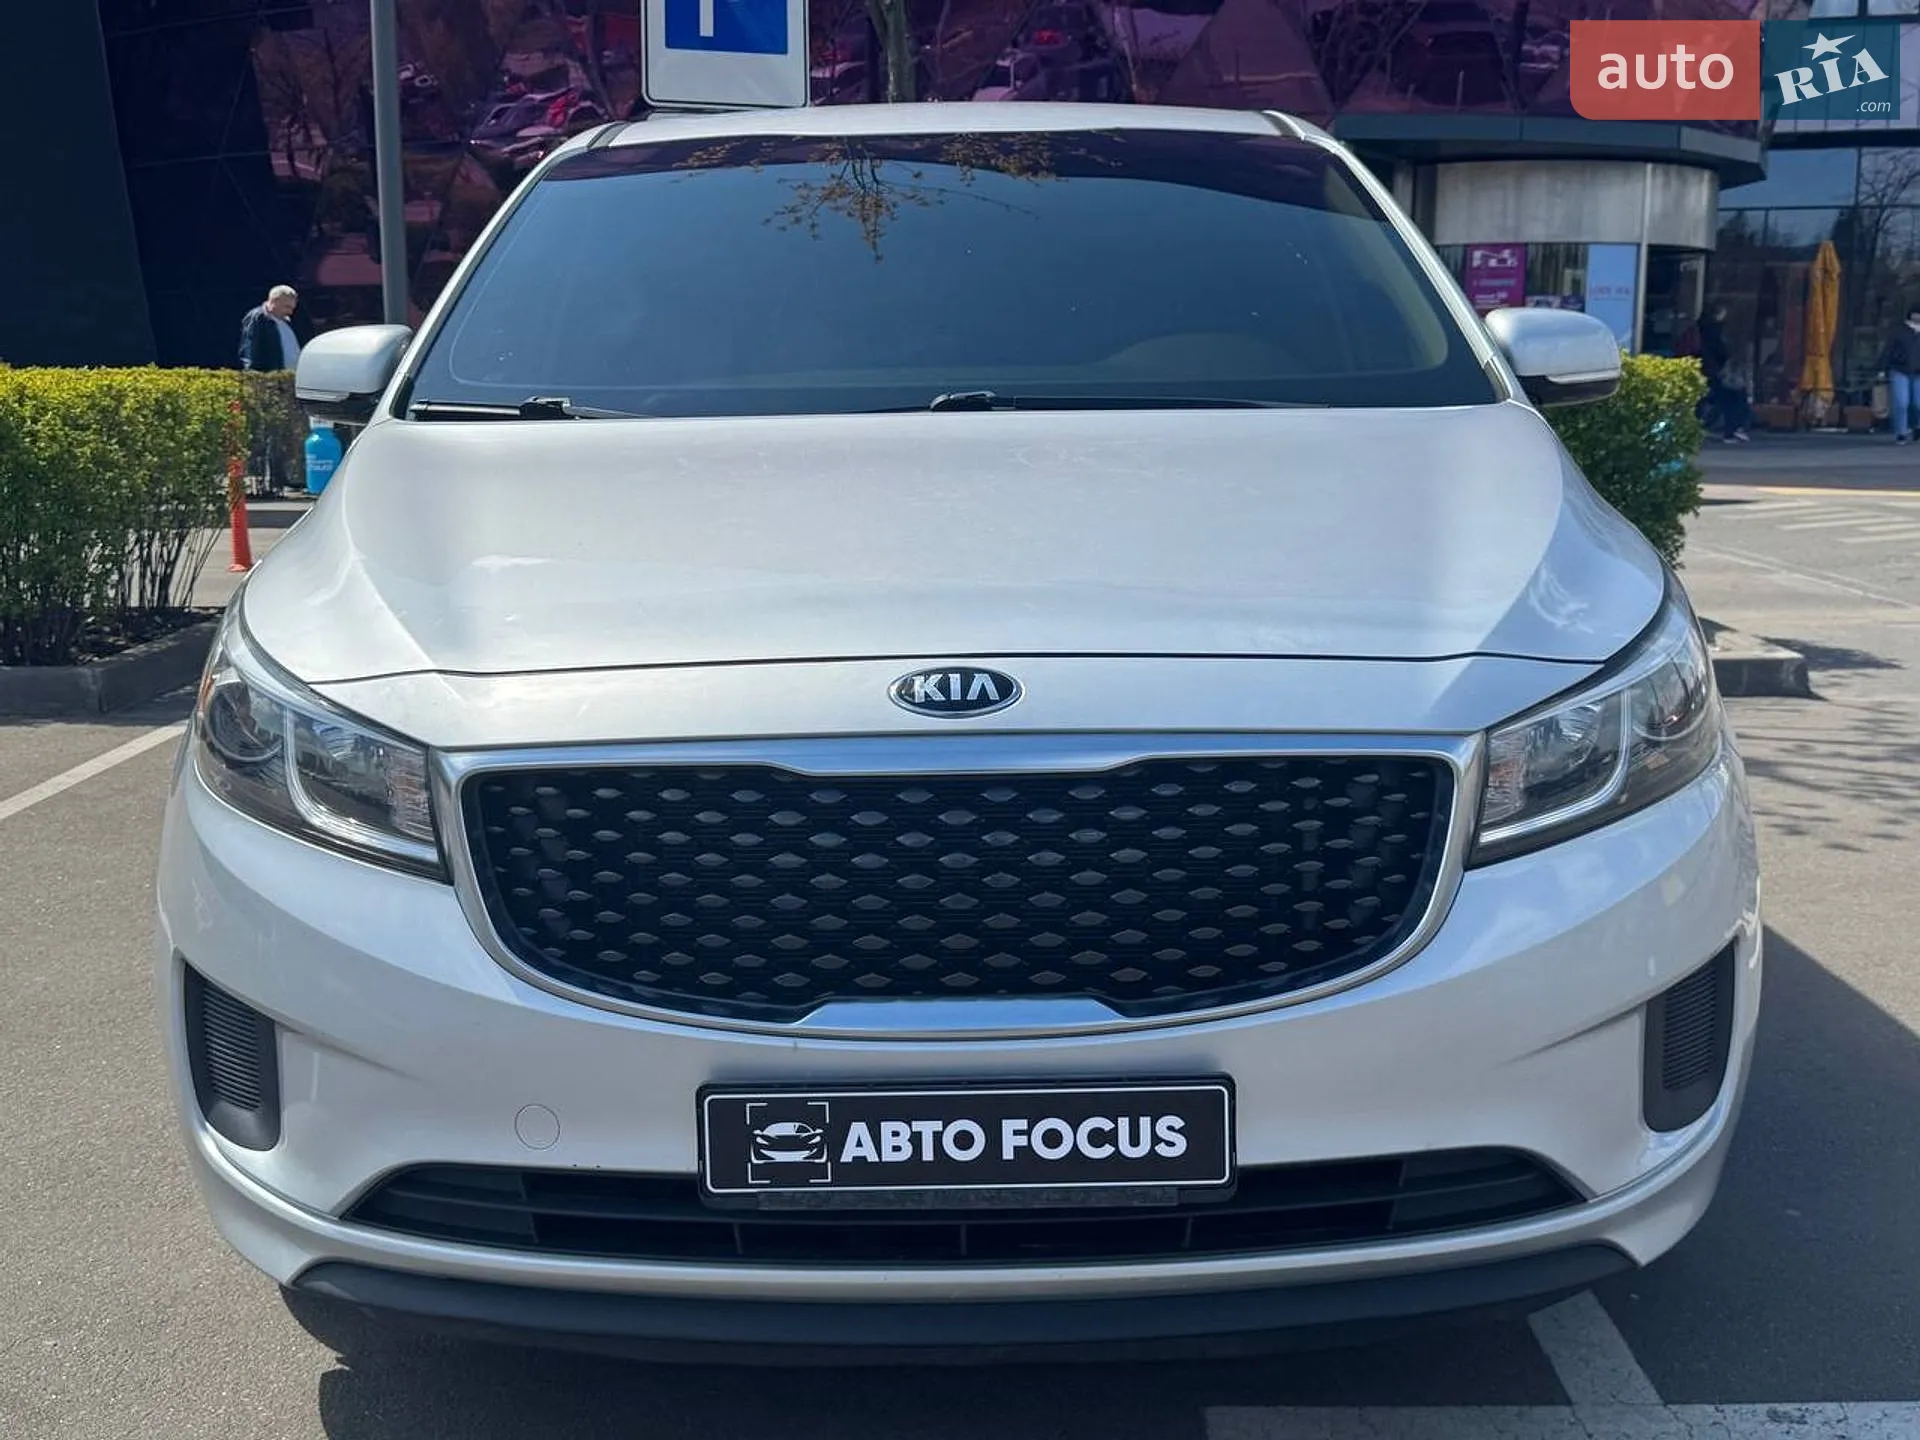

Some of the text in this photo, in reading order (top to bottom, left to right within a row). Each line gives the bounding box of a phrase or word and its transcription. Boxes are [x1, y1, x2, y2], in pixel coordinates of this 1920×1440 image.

[912, 672, 1001, 704] KIA
[839, 1114, 1188, 1163] АВТО FOCUS
